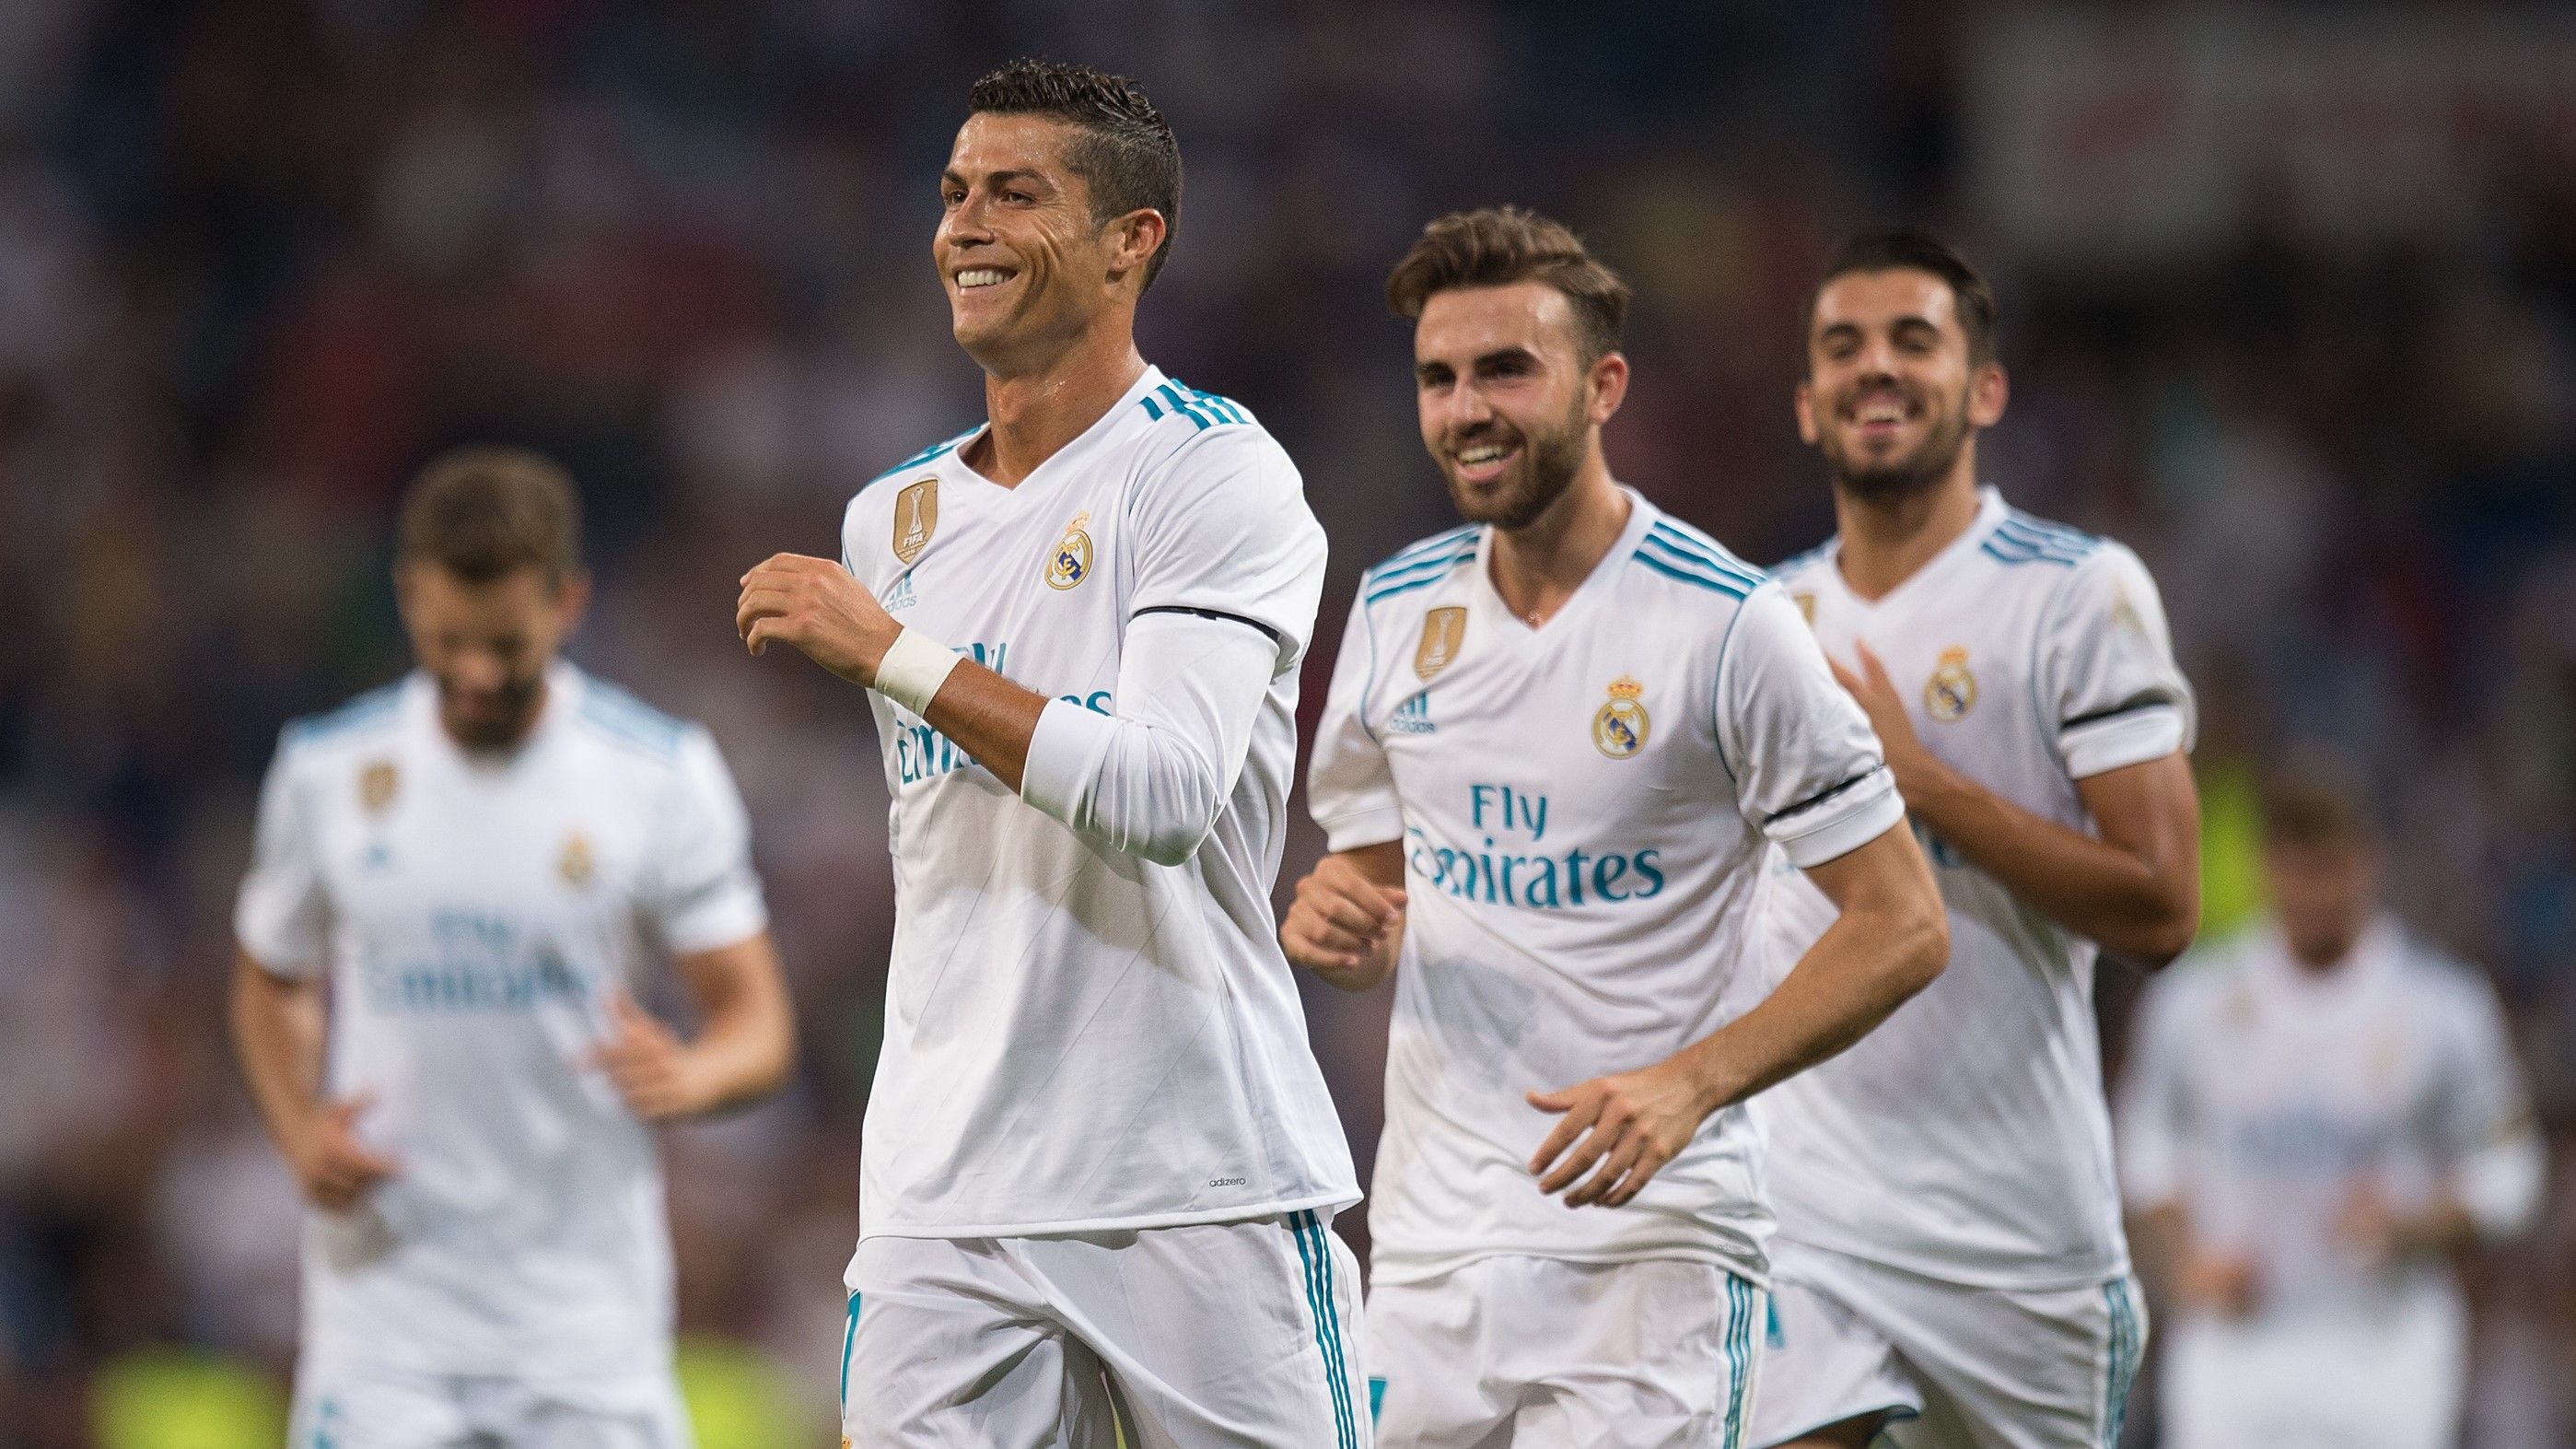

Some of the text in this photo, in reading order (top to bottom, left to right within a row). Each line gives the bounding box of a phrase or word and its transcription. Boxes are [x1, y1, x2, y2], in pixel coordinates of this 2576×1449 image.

[903, 532, 924, 548] FIFA
[1470, 784, 1547, 841] Fly
[1208, 1177, 1246, 1187] adizero
